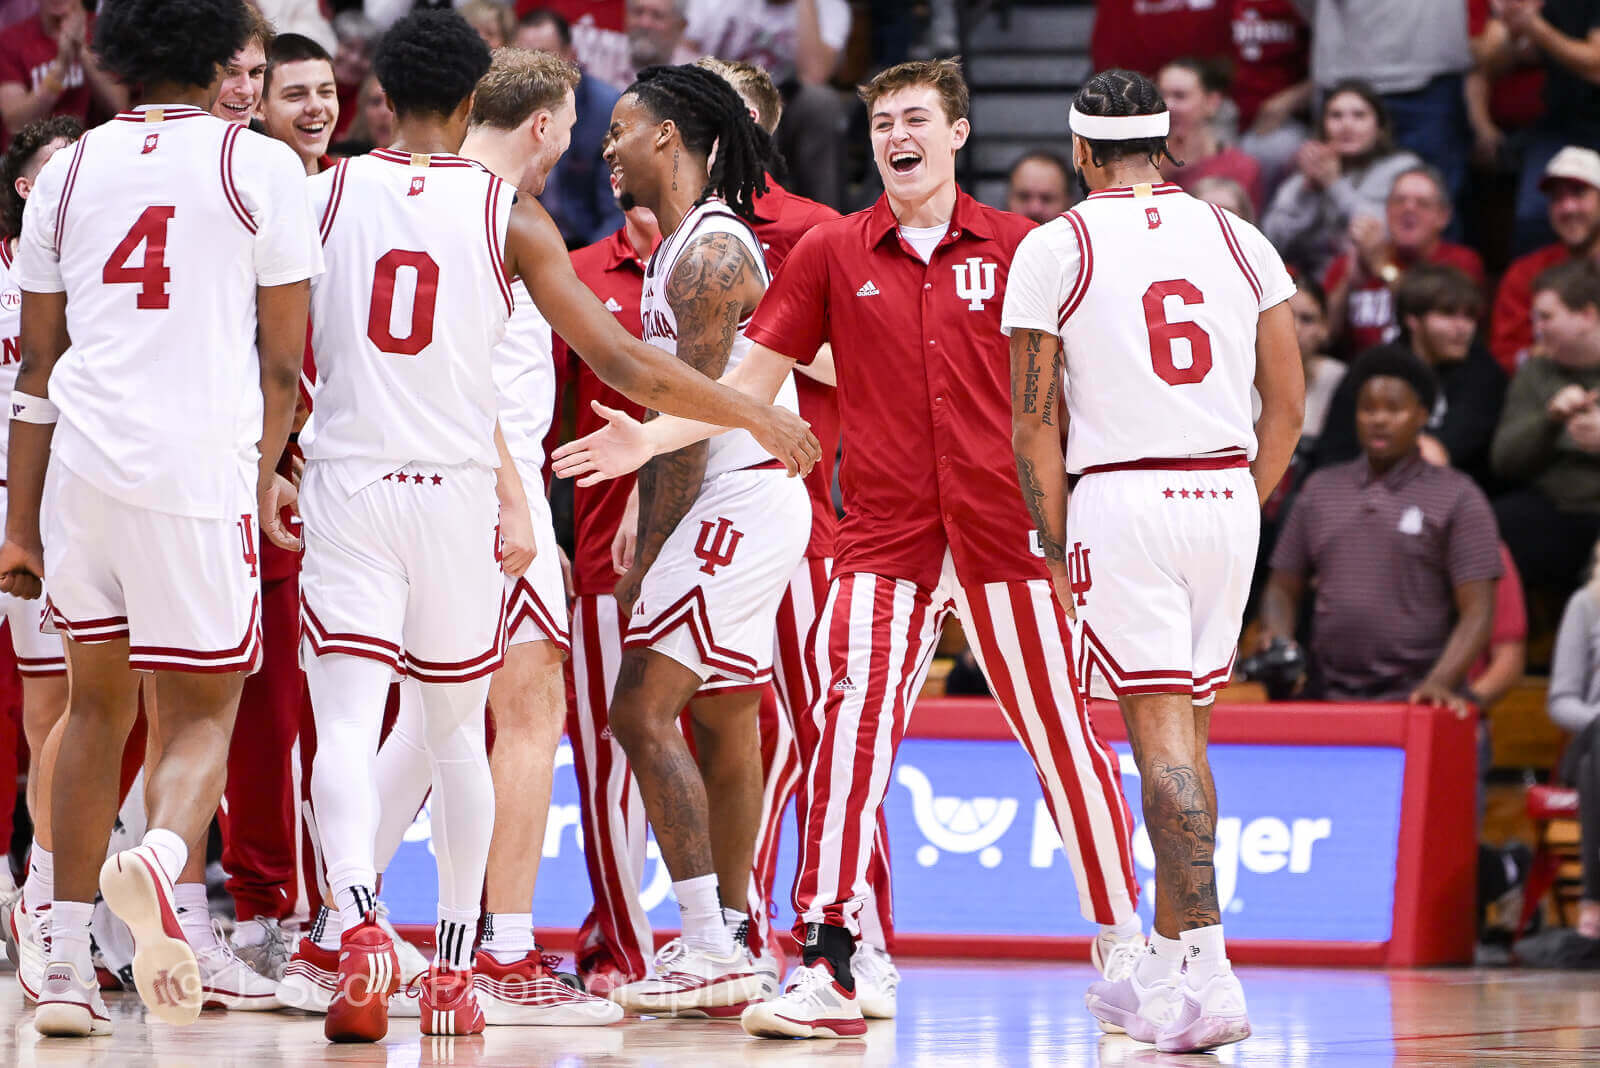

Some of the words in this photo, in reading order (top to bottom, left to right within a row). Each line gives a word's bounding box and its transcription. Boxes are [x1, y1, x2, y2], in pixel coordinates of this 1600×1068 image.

[103, 206, 175, 309] 4
[367, 249, 440, 355] 0
[1142, 279, 1213, 385] 6
